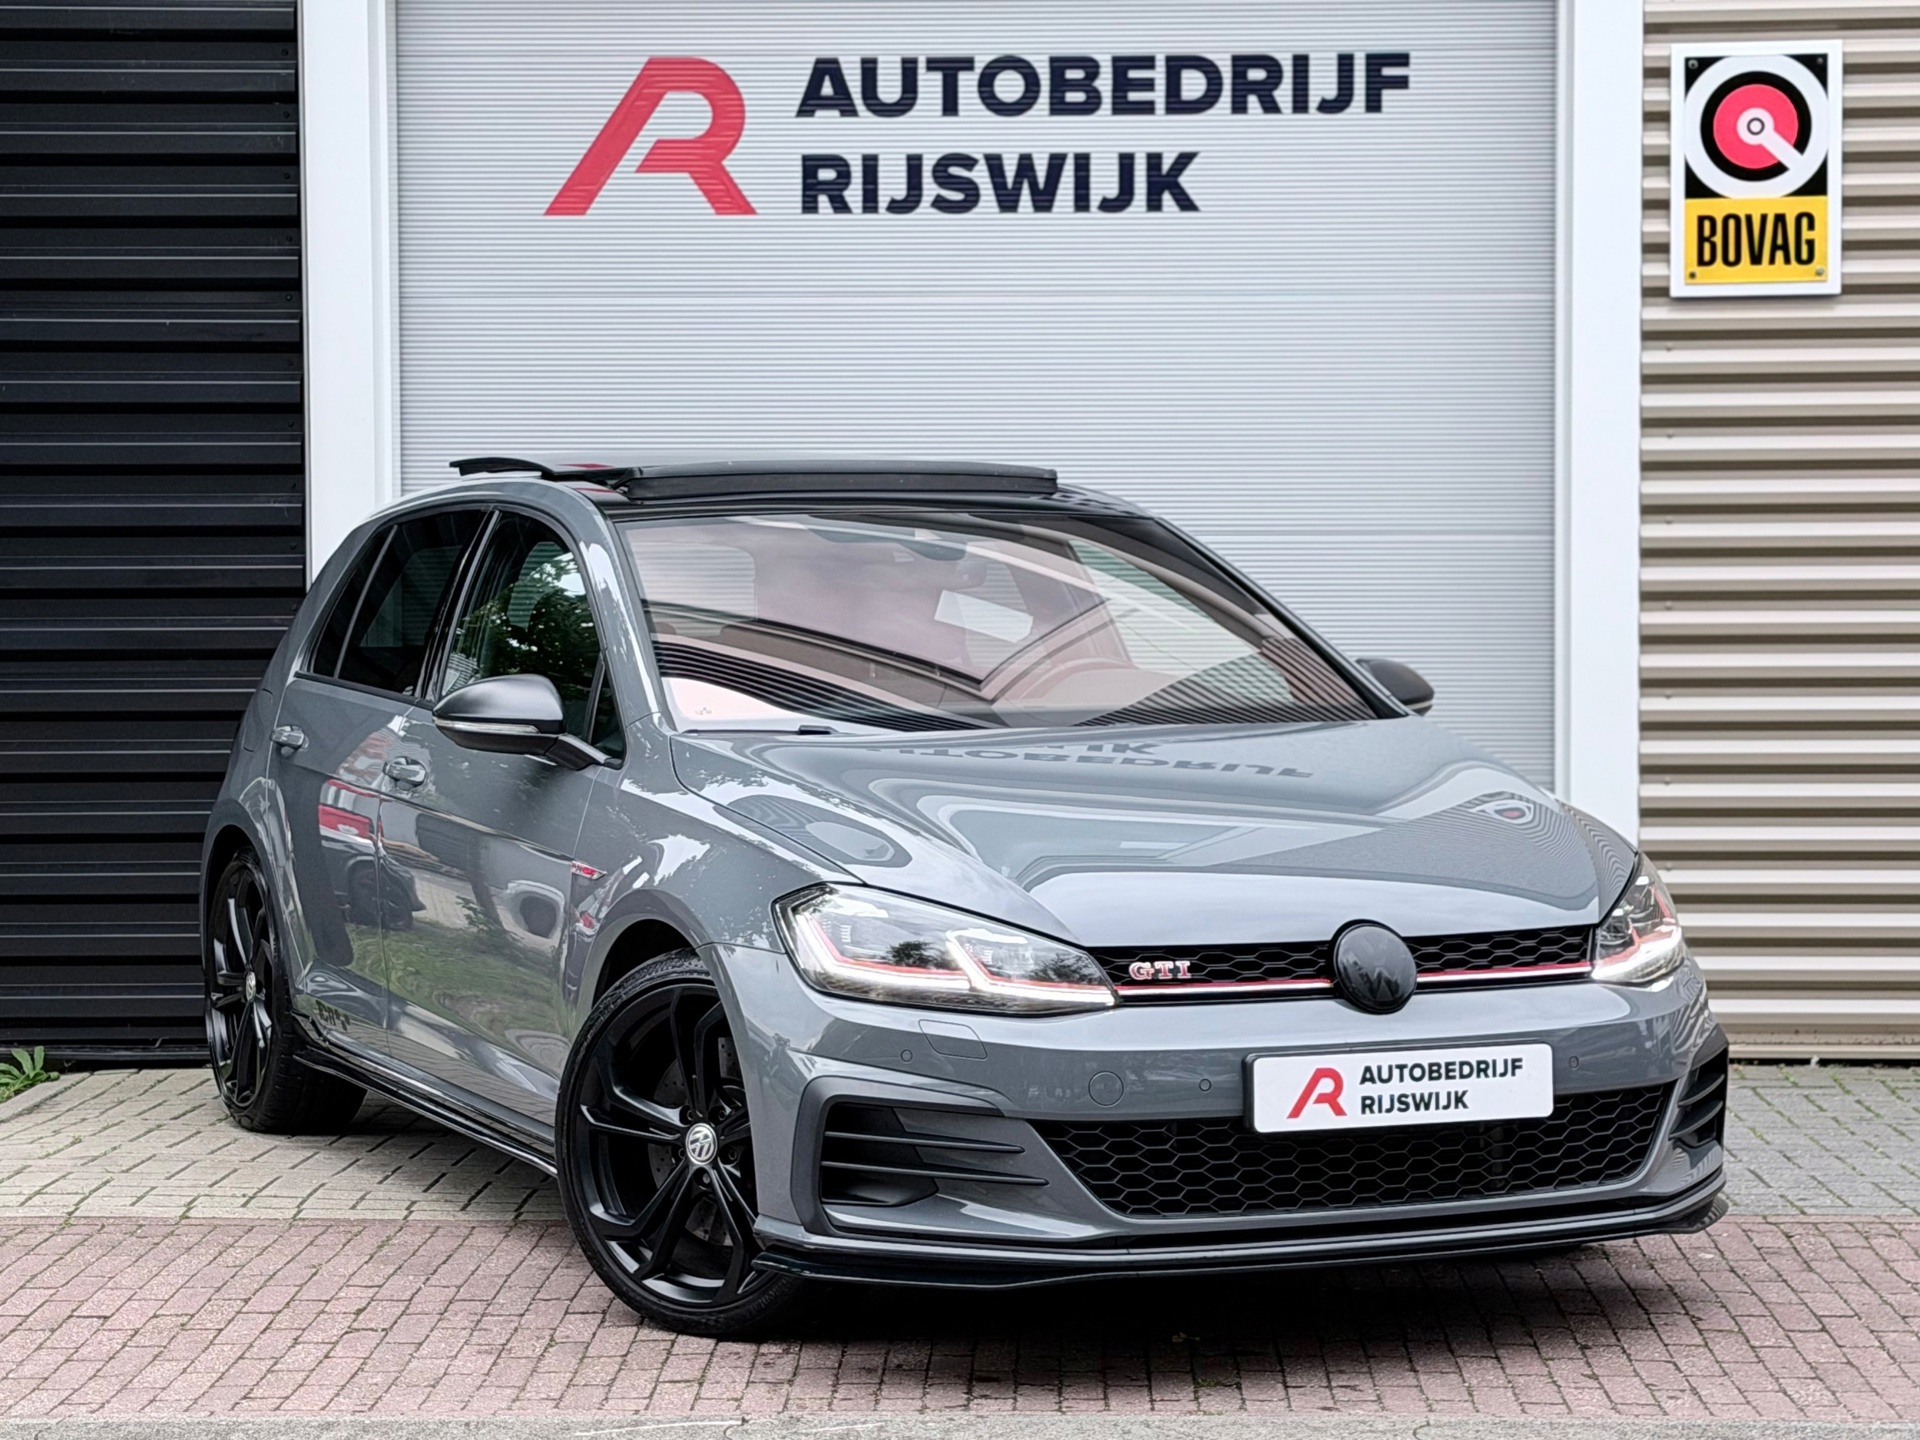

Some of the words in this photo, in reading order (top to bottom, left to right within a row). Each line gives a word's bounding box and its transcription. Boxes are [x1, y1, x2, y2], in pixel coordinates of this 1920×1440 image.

[796, 52, 1411, 118] AUTOBEDRIJF
[801, 152, 1199, 214] RIJSWIJK
[1697, 211, 1815, 267] BOVAG
[1128, 960, 1192, 981] GTI
[1359, 1057, 1523, 1085] AUTOBEDRIJF
[1360, 1090, 1470, 1115] RIJSWIJK
